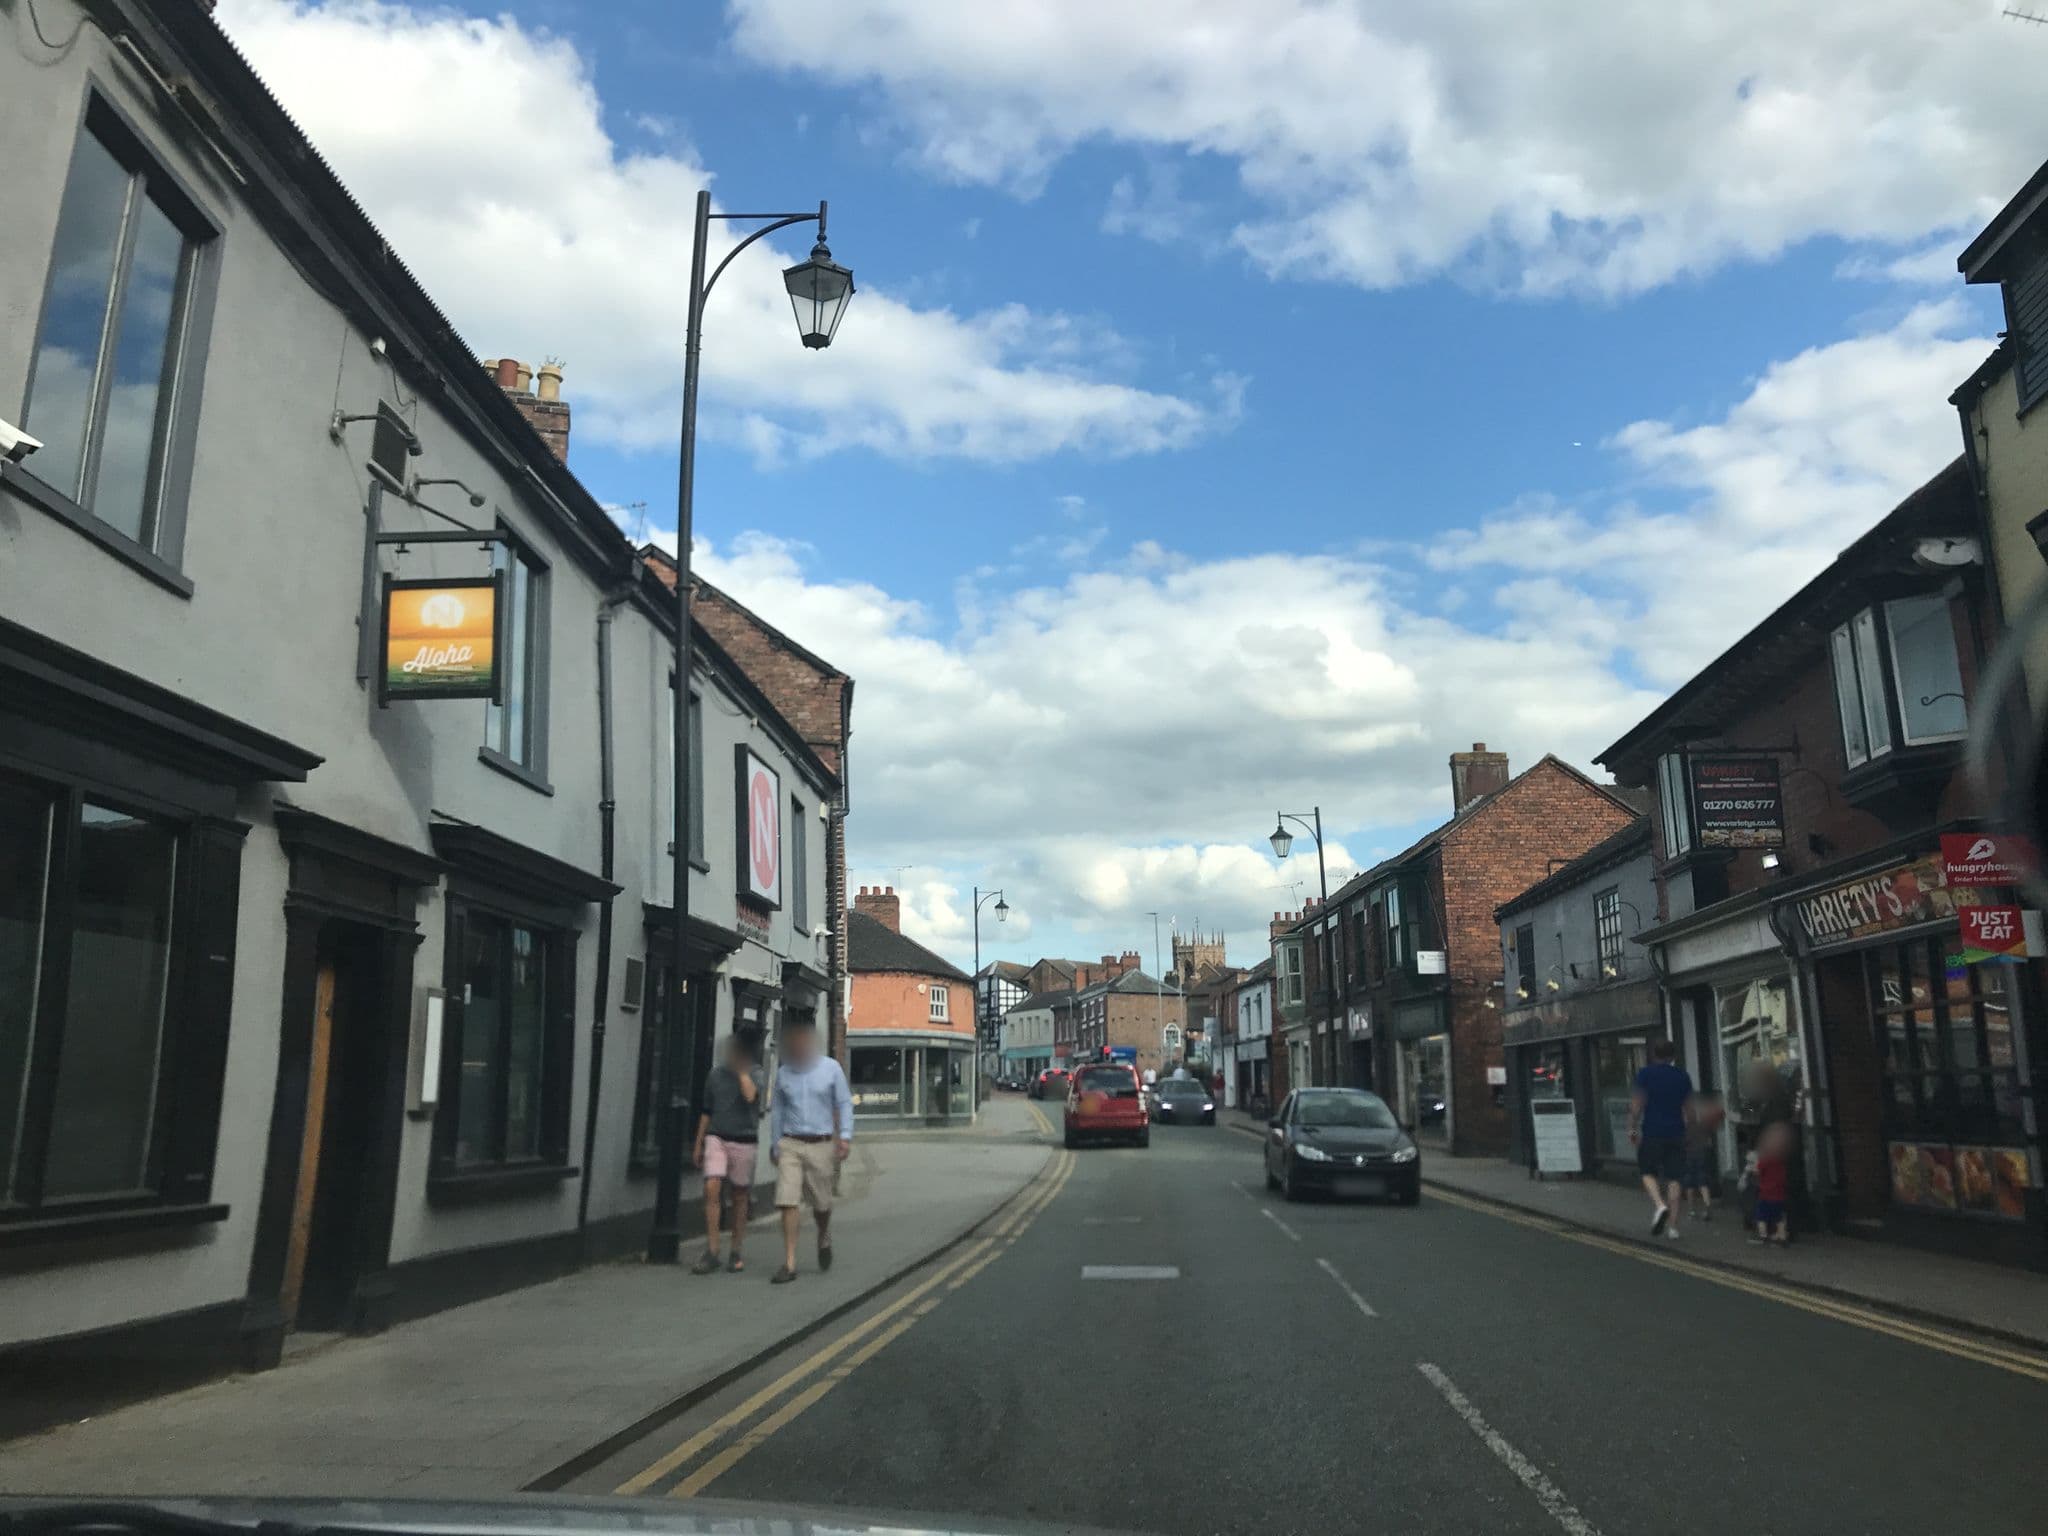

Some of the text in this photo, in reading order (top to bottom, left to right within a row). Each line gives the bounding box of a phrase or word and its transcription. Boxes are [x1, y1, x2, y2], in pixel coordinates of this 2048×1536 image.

[403, 644, 474, 673] Aloha
[1703, 800, 1775, 810] 01270 626 777
[1947, 861, 2022, 874] hungryhou
[1797, 876, 1903, 937] VARIETY'S
[1970, 911, 2012, 927] JUST
[1980, 925, 2014, 939] EAT
